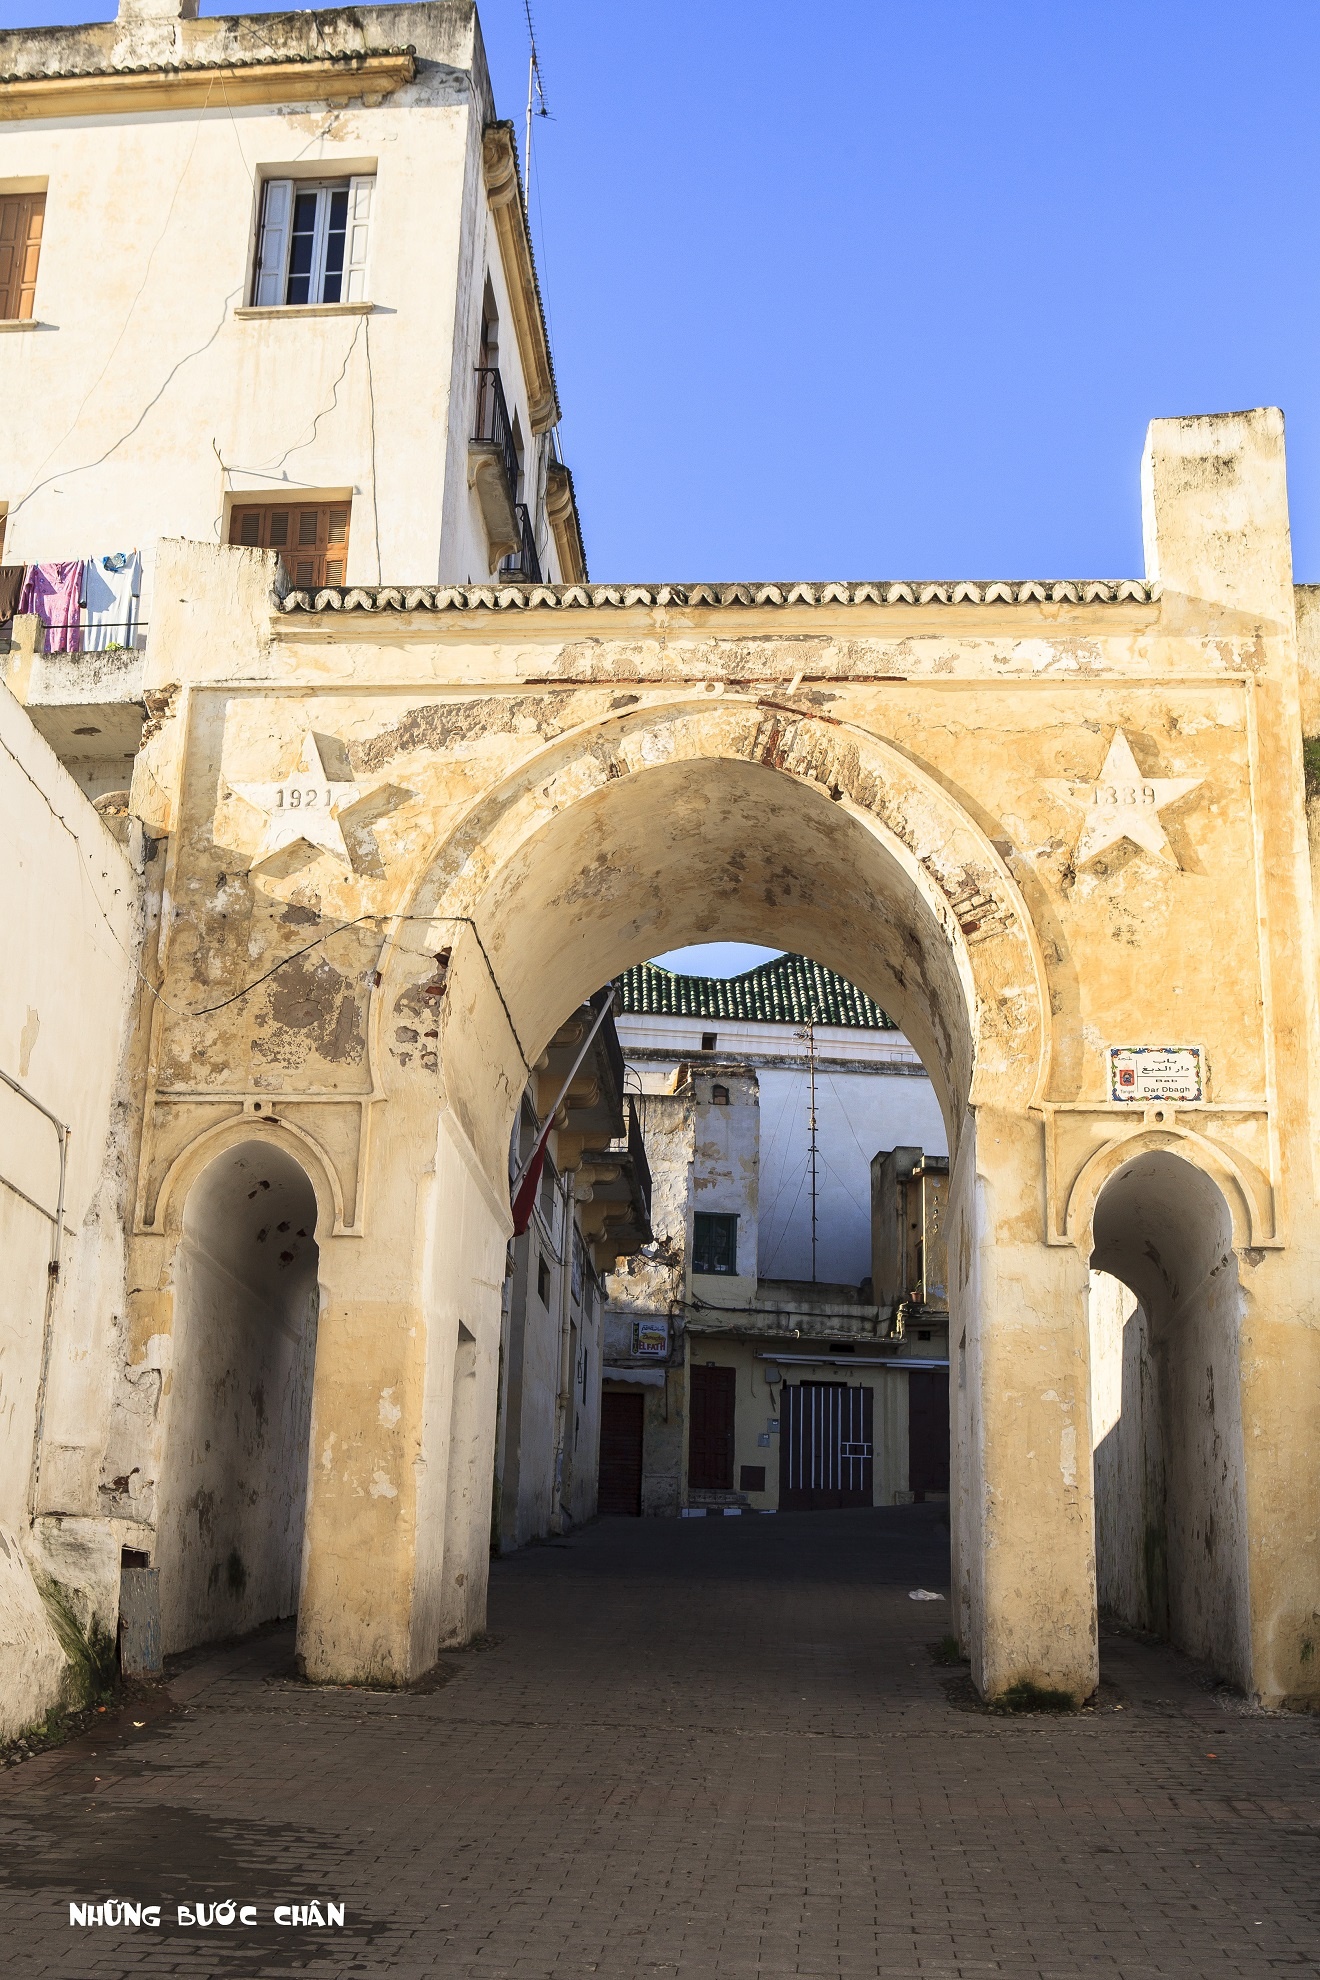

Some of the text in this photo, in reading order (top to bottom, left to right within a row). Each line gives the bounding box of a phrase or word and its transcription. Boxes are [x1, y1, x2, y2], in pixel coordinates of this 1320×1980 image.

[276, 788, 332, 808] 1921
[1091, 786, 1156, 805] 1339
[1174, 1065, 1190, 1073] دار
[1161, 1086, 1191, 1094] Dbagh
